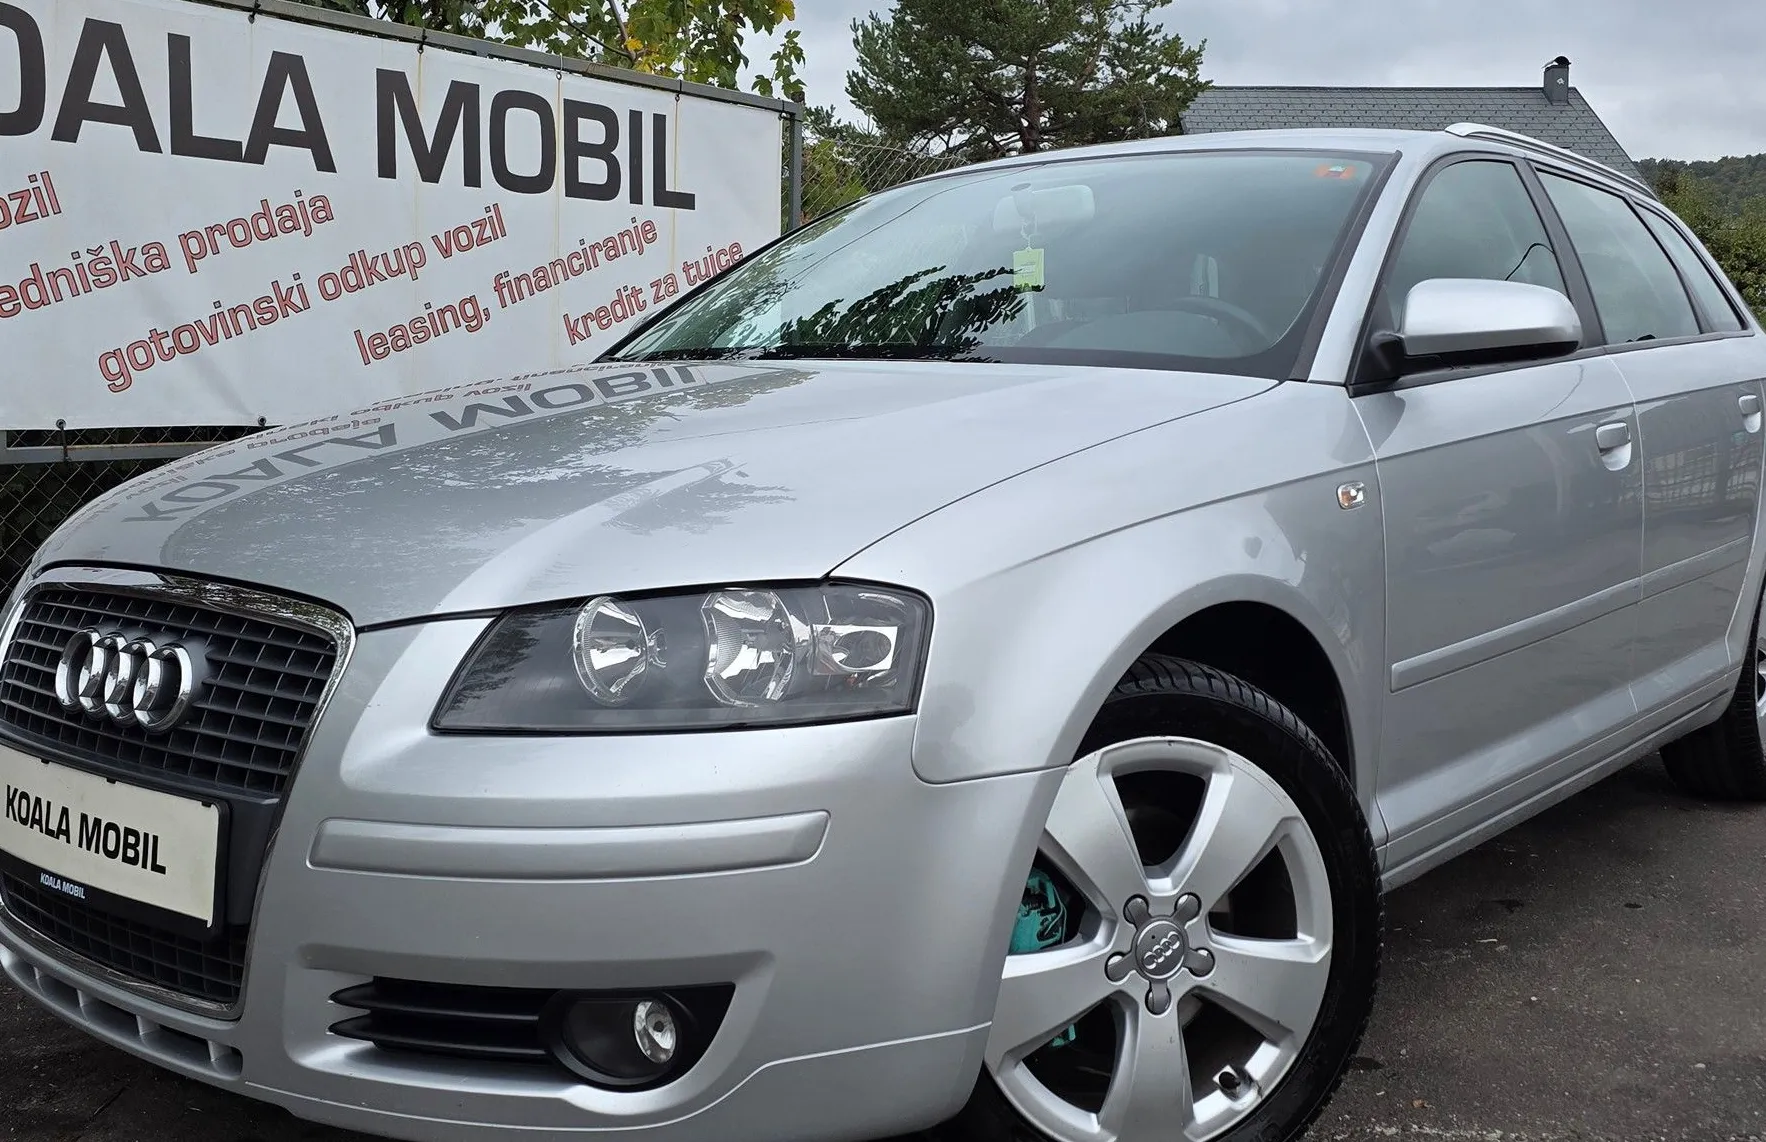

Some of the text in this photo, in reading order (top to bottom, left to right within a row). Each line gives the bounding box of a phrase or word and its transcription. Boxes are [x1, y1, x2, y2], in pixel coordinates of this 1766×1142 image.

[375, 67, 696, 211] MOBIL
[178, 189, 335, 274] prodaja
[98, 272, 311, 393] gotovinski
[317, 239, 427, 302] odkup
[431, 203, 508, 260] vozil
[354, 216, 659, 366] leasing, financiranje
[563, 284, 647, 346] kredit
[649, 272, 680, 305] za
[5, 783, 168, 876] KOALA MOBIL
[40, 872, 86, 900] KOALA MOBIL
